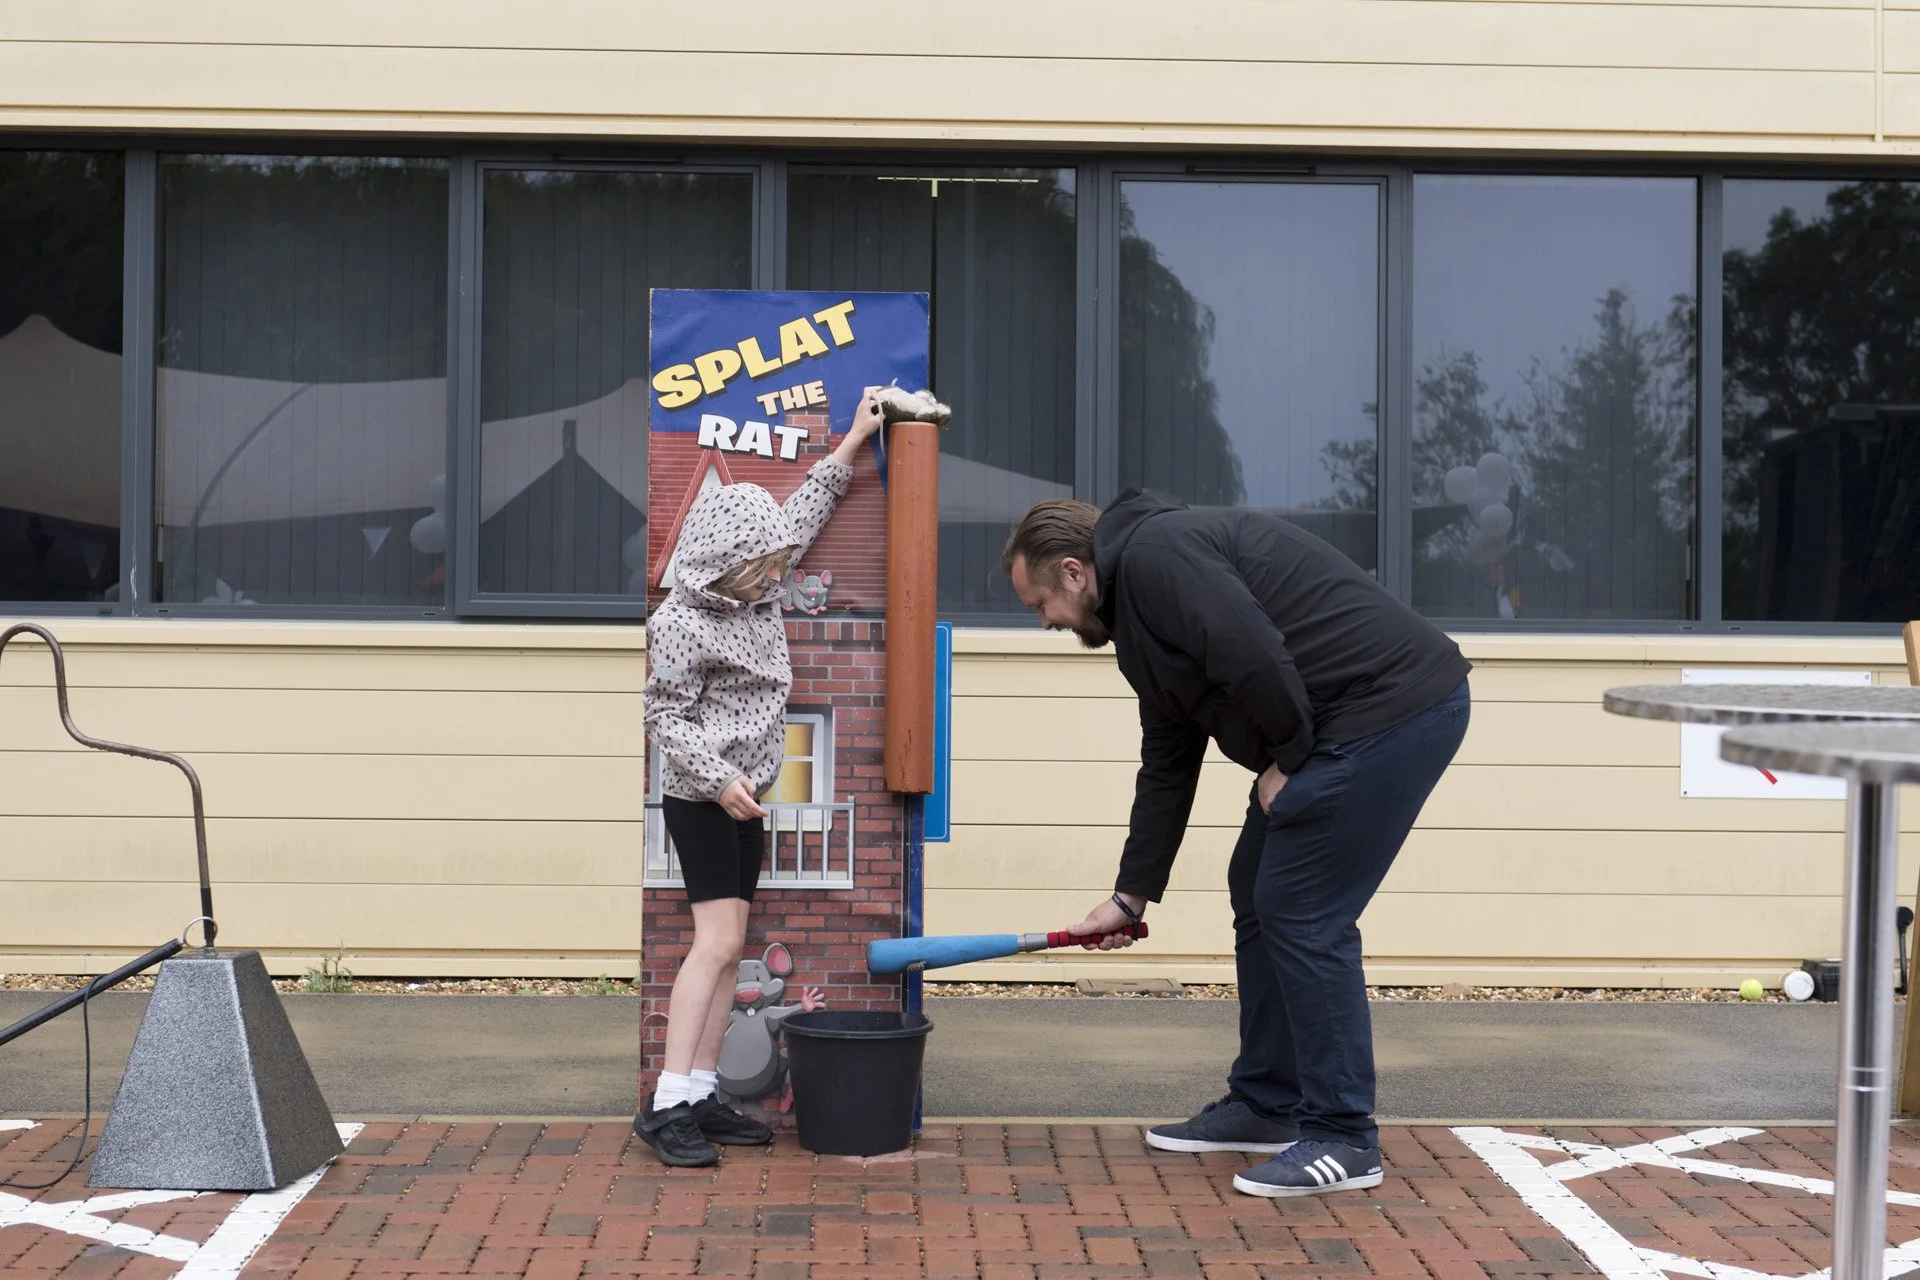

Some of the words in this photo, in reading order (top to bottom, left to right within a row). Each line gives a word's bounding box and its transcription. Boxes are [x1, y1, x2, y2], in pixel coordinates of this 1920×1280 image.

[652, 300, 855, 410] SPLAT
[757, 380, 827, 416] THE
[697, 413, 809, 461] RAT
[1367, 1166, 1382, 1174] adida
